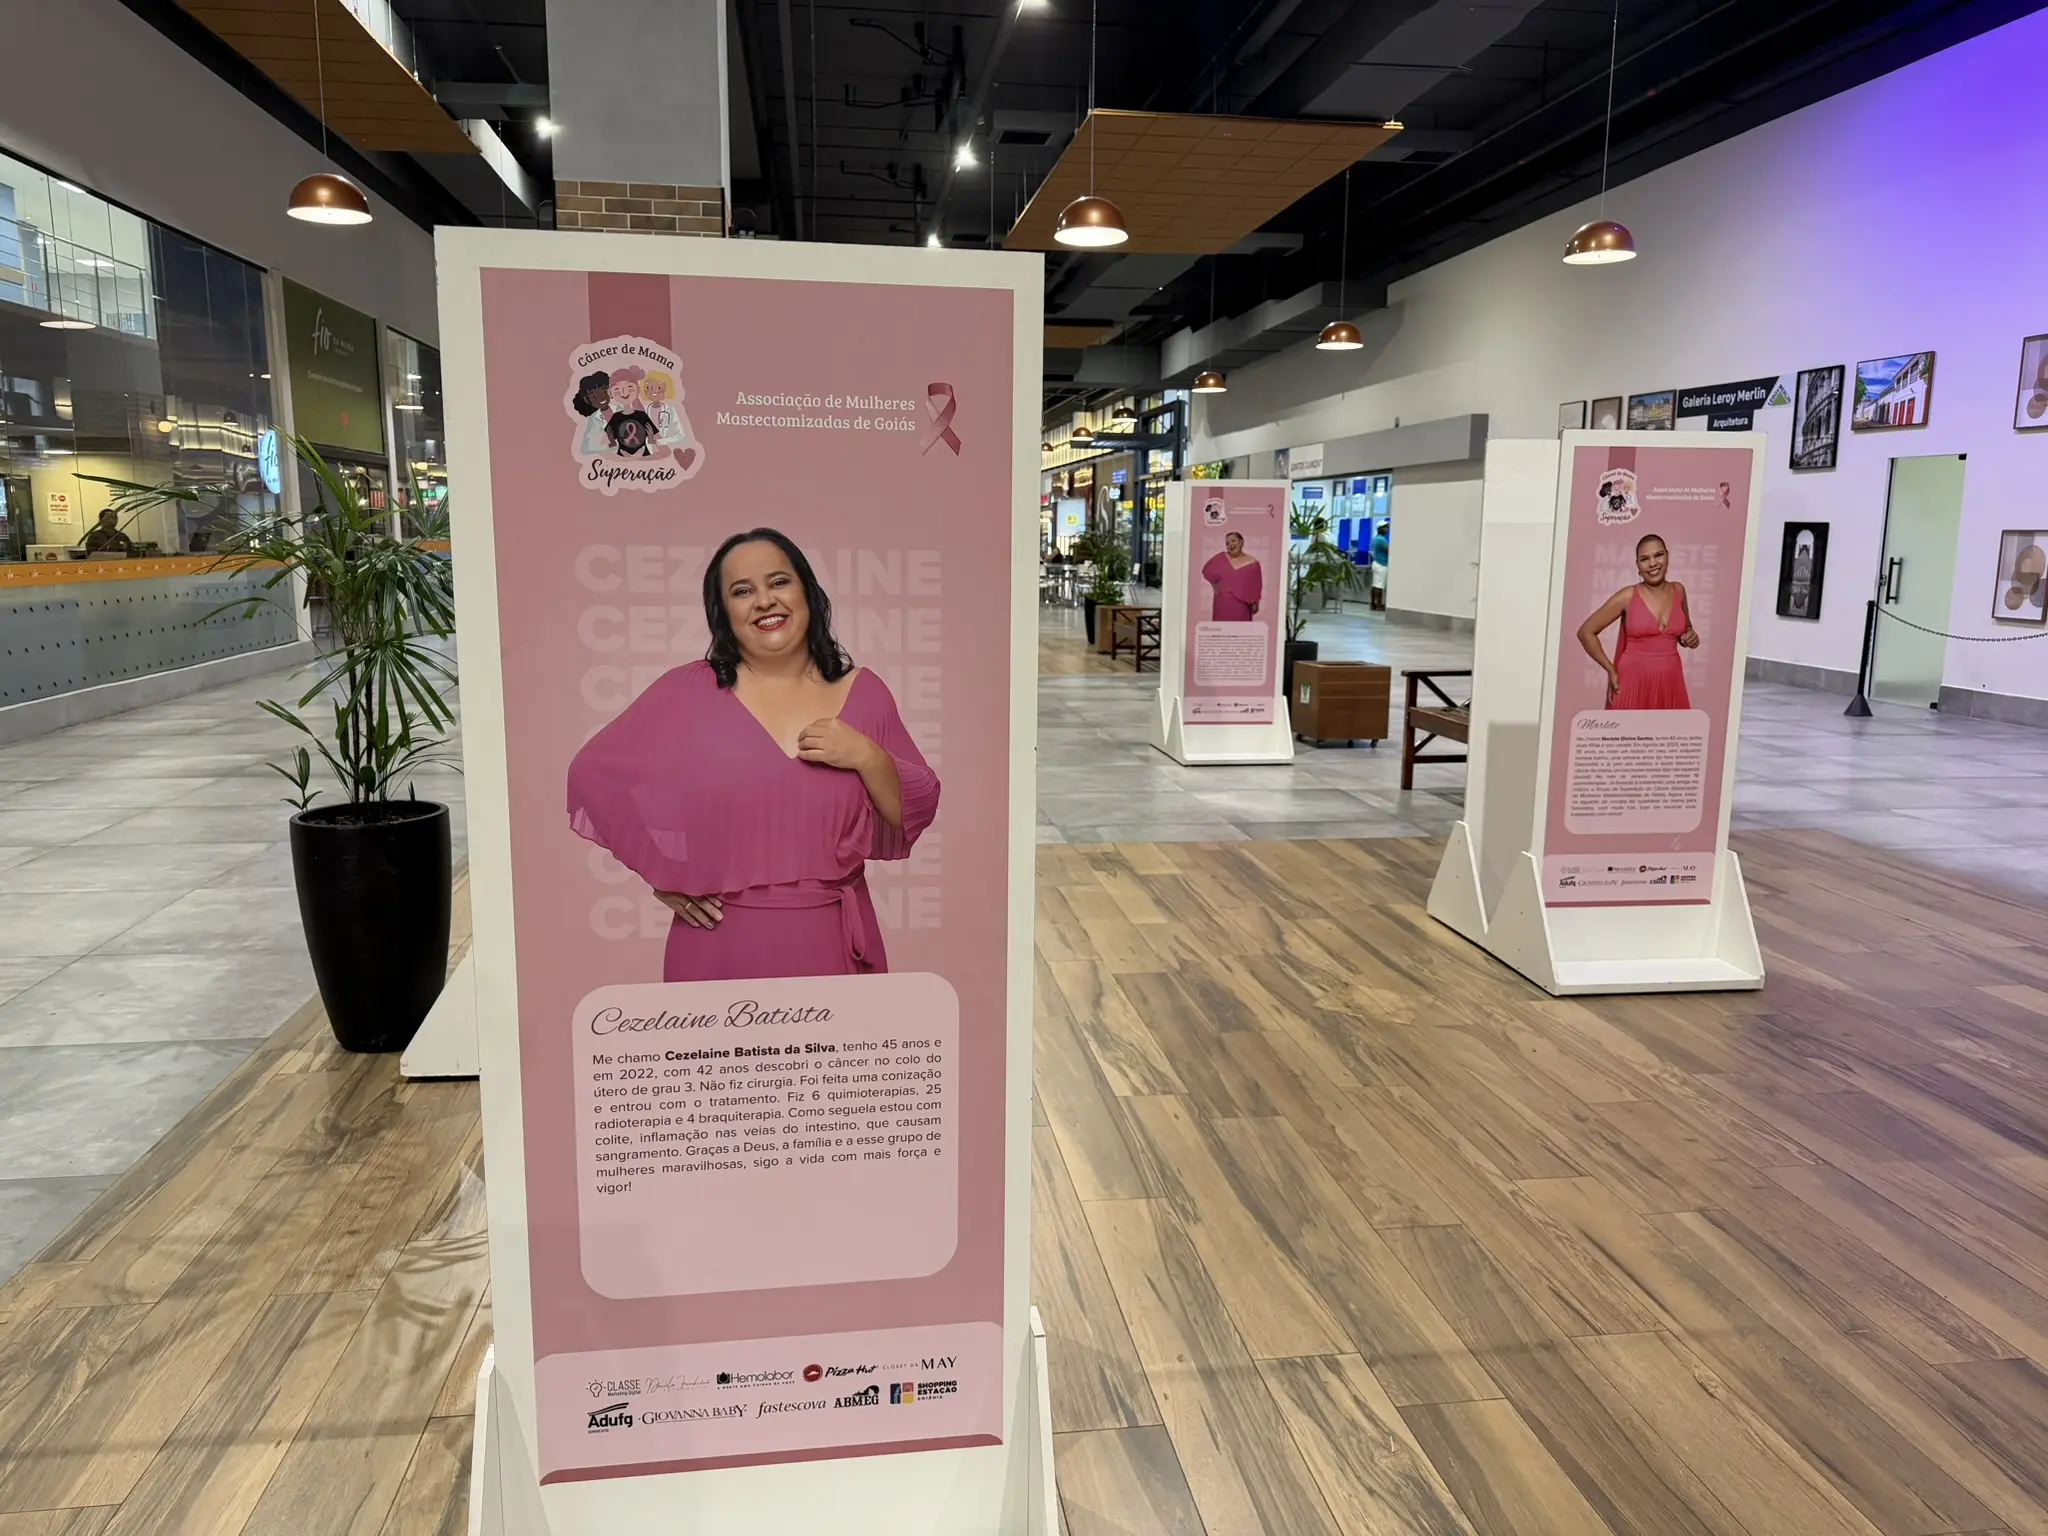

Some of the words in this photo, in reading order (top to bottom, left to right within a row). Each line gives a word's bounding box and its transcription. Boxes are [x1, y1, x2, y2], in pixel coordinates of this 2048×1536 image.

[578, 345, 618, 368] Câncer
[621, 343, 636, 355] de
[638, 345, 675, 370] Mama
[736, 391, 821, 411] Associação
[825, 395, 842, 408] de
[846, 395, 916, 411] Mulheres
[1682, 394, 1711, 409] Galeria
[1712, 392, 1737, 406] Leroy
[1737, 386, 1766, 402] Merlin
[716, 411, 850, 429] Mastectomizadas
[854, 416, 871, 430] de
[874, 416, 916, 431] Goiás
[1713, 416, 1749, 429] Arquitetura
[588, 458, 677, 487] Superação
[591, 1007, 719, 1036] Cezelaine
[724, 1000, 835, 1028] Batista
[593, 1054, 613, 1065] Me
[617, 1053, 661, 1064] chamo
[665, 1048, 730, 1061] Cezelaine
[734, 1045, 780, 1057] Batista
[784, 1044, 800, 1055] da
[804, 1042, 839, 1054] Silva,
[842, 1040, 878, 1052] tenho
[881, 1039, 898, 1050] 45
[901, 1039, 930, 1049] anos
[934, 1039, 942, 1048] e
[593, 1072, 613, 1082] em
[619, 1068, 658, 1080] 2022,
[663, 1068, 691, 1078] com
[696, 1064, 713, 1076] 42
[719, 1065, 749, 1074] anos
[755, 1059, 809, 1072] descobri
[814, 1061, 823, 1069] o
[827, 1057, 870, 1068] câncer
[874, 1057, 890, 1066] no
[895, 1054, 921, 1065] colo
[926, 1053, 942, 1064] do
[593, 1086, 628, 1098] útero
[631, 1085, 648, 1096] de
[651, 1085, 681, 1097] grau
[684, 1081, 696, 1093] 3.
[700, 1080, 726, 1091] Não
[729, 1079, 743, 1090] fiz
[747, 1076, 796, 1090] cirurgia.
[800, 1074, 818, 1086] Foi
[822, 1074, 848, 1084] feita
[852, 1074, 878, 1083] uma
[881, 1068, 942, 1081] conização
[594, 1105, 602, 1114] e
[610, 1102, 652, 1113] entrou
[659, 1100, 686, 1110] com
[693, 1099, 702, 1108] o
[709, 1094, 780, 1107] tratamento.
[787, 1091, 805, 1102] Fiz
[812, 1090, 820, 1101] 6
[827, 1086, 919, 1102] quimioterapias,
[926, 1083, 942, 1095] 25
[595, 1115, 671, 1130] radioterapia
[675, 1116, 683, 1125] e
[687, 1113, 695, 1124] 4
[699, 1110, 785, 1124] braquiterapia.
[788, 1107, 825, 1118] Como
[879, 1103, 913, 1113] estou
[916, 1101, 942, 1111] com
[595, 1134, 633, 1146] colite,
[640, 1129, 709, 1143] inflamação
[715, 1129, 737, 1138] nas
[743, 1125, 776, 1136] veias
[782, 1124, 799, 1134] do
[805, 1120, 860, 1132] intestino,
[866, 1120, 889, 1131] que
[895, 1117, 941, 1127] causam
[595, 1148, 682, 1163] sangramento.
[685, 1145, 729, 1156] Graças
[732, 1145, 740, 1153] a
[743, 1142, 779, 1152] Deus,
[782, 1142, 789, 1150] a
[793, 1137, 832, 1149] família
[835, 1138, 843, 1147] e
[846, 1138, 853, 1146] a
[856, 1136, 885, 1145] esse
[887, 1133, 923, 1146] grupo
[926, 1131, 942, 1141] de
[596, 1166, 655, 1178] mulheres
[662, 1160, 747, 1173] maravilhosas,
[753, 1157, 779, 1169] sigo
[785, 1157, 793, 1166] a
[799, 1153, 825, 1164] vida
[831, 1153, 857, 1163] com
[863, 1149, 891, 1160] mais
[897, 1148, 927, 1159] força
[933, 1148, 941, 1156] e
[596, 1181, 632, 1195] vigor!
[825, 1366, 855, 1378] Pizza
[856, 1364, 877, 1375] Hut
[921, 1356, 957, 1370] MAY
[607, 1379, 641, 1392] CLASSE
[731, 1370, 795, 1384] Hemolabor
[917, 1380, 957, 1389] SHOPPING
[756, 1400, 826, 1419] fastescova
[834, 1394, 880, 1408] ABMEG
[588, 1413, 633, 1428] Adufg
[642, 1408, 710, 1425] GIOVANNA
[712, 1404, 745, 1418] BABY
